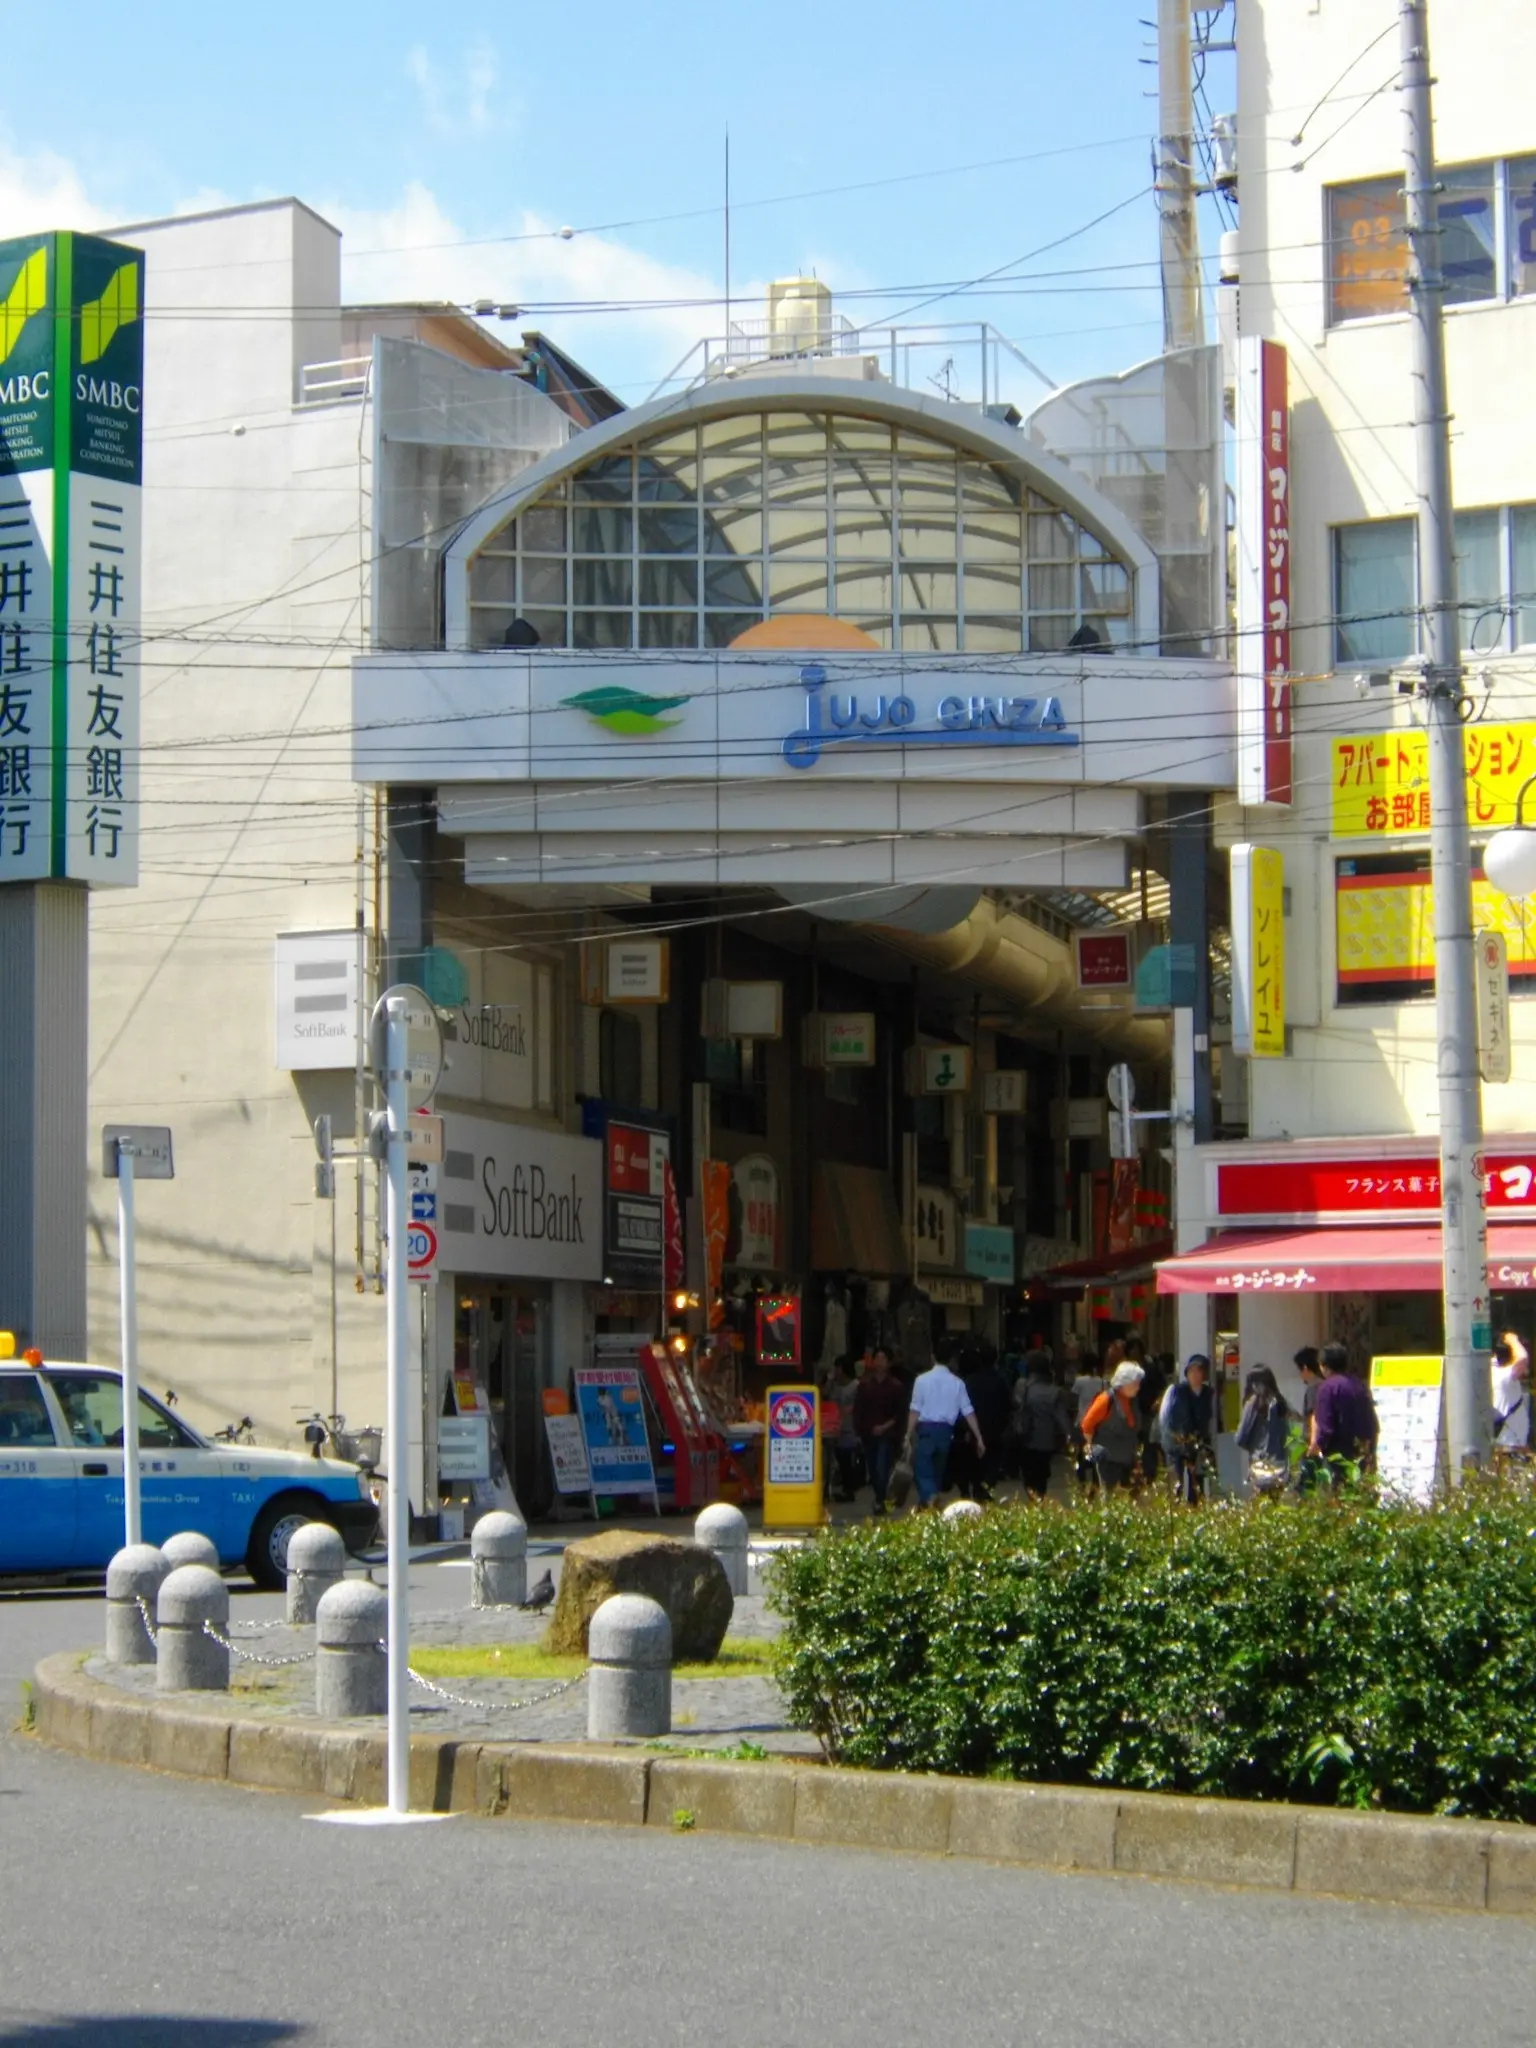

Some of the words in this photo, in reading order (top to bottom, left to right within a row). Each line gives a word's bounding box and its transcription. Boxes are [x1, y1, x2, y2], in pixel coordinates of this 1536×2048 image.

[76, 373, 140, 413] SMBC
[86, 413, 128, 430] SUMITOMO
[94, 427, 120, 441] MITSUI
[79, 449, 134, 469] CORPORATION
[90, 438, 125, 455] BANKING
[1268, 466, 1290, 735] コージーコーナー
[0, 499, 33, 857] 三井住友銀行
[85, 500, 124, 858] 三井住友銀行
[937, 696, 1067, 731] GINZA
[1338, 731, 1523, 788] アパートション
[1256, 907, 1273, 1036] ソレイユ
[293, 1022, 348, 1038] SoftBank
[461, 1001, 527, 1056] SoftBank
[482, 1156, 585, 1244] SoftBank
[1345, 1175, 1440, 1194] フランス菓子
[1231, 1267, 1317, 1289] コージーコーナー
